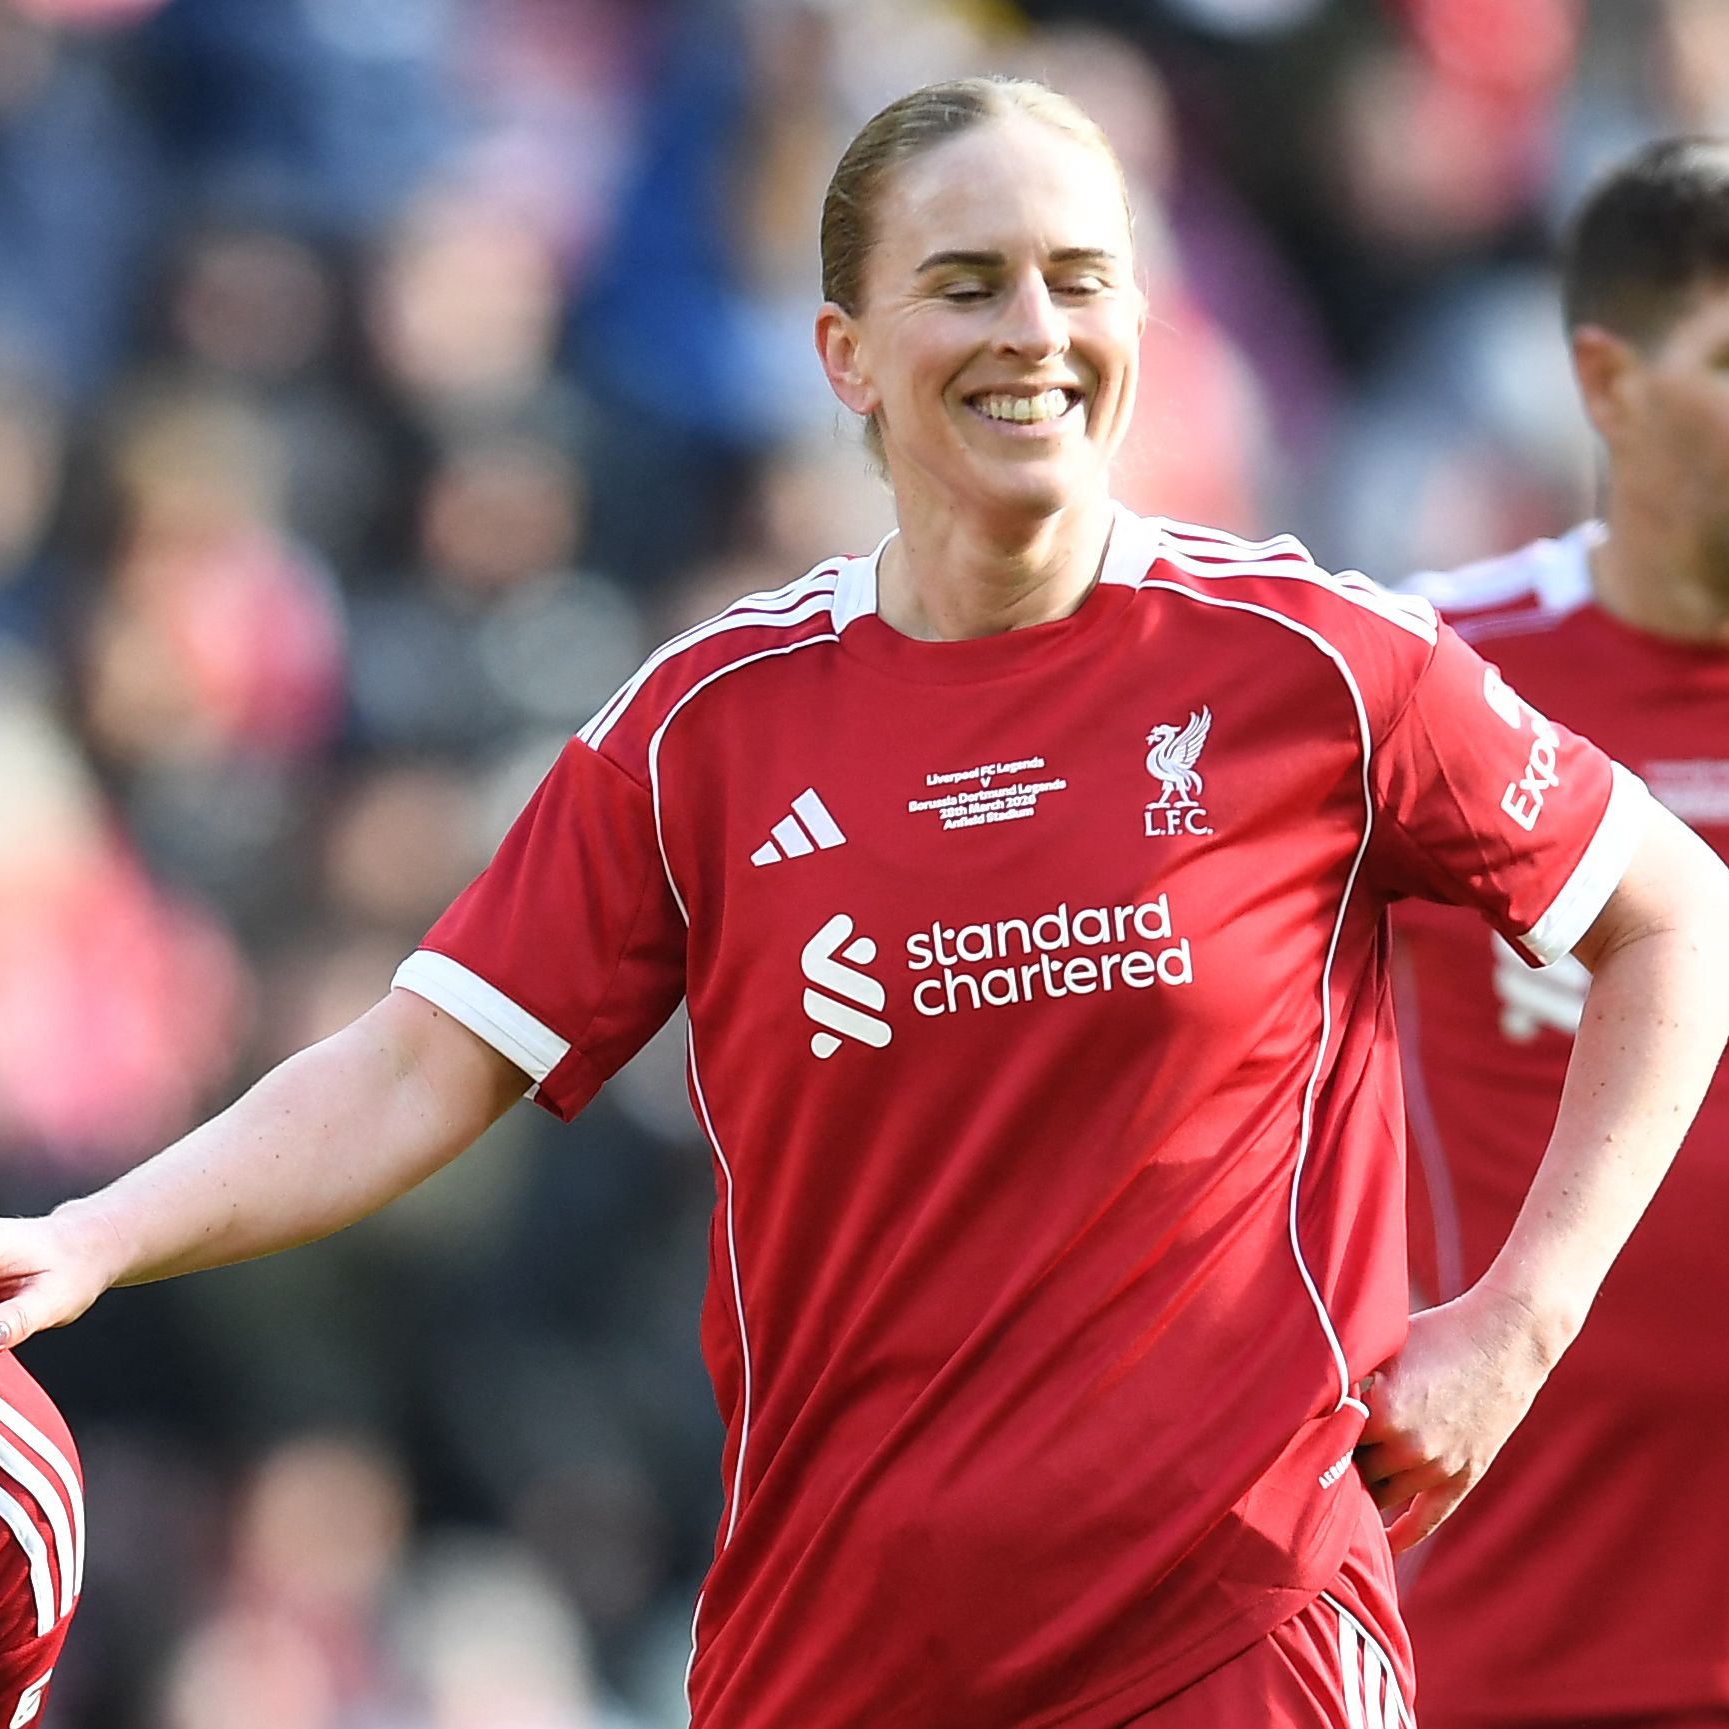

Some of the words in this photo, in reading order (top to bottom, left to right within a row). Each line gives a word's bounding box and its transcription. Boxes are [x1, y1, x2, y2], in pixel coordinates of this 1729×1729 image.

[926, 768, 979, 787] Liverpool
[980, 765, 996, 777] FC
[997, 756, 1046, 774] Legends
[908, 796, 958, 813] Borussia
[958, 784, 1017, 804] Dortmund
[1018, 778, 1067, 794] Legends
[969, 800, 1004, 814] March
[943, 814, 985, 830] Anfield
[986, 807, 1035, 823] Stadium
[1144, 808, 1214, 837] L.F.C.
[905, 893, 1173, 972] standard
[912, 939, 1194, 1017] chartered
